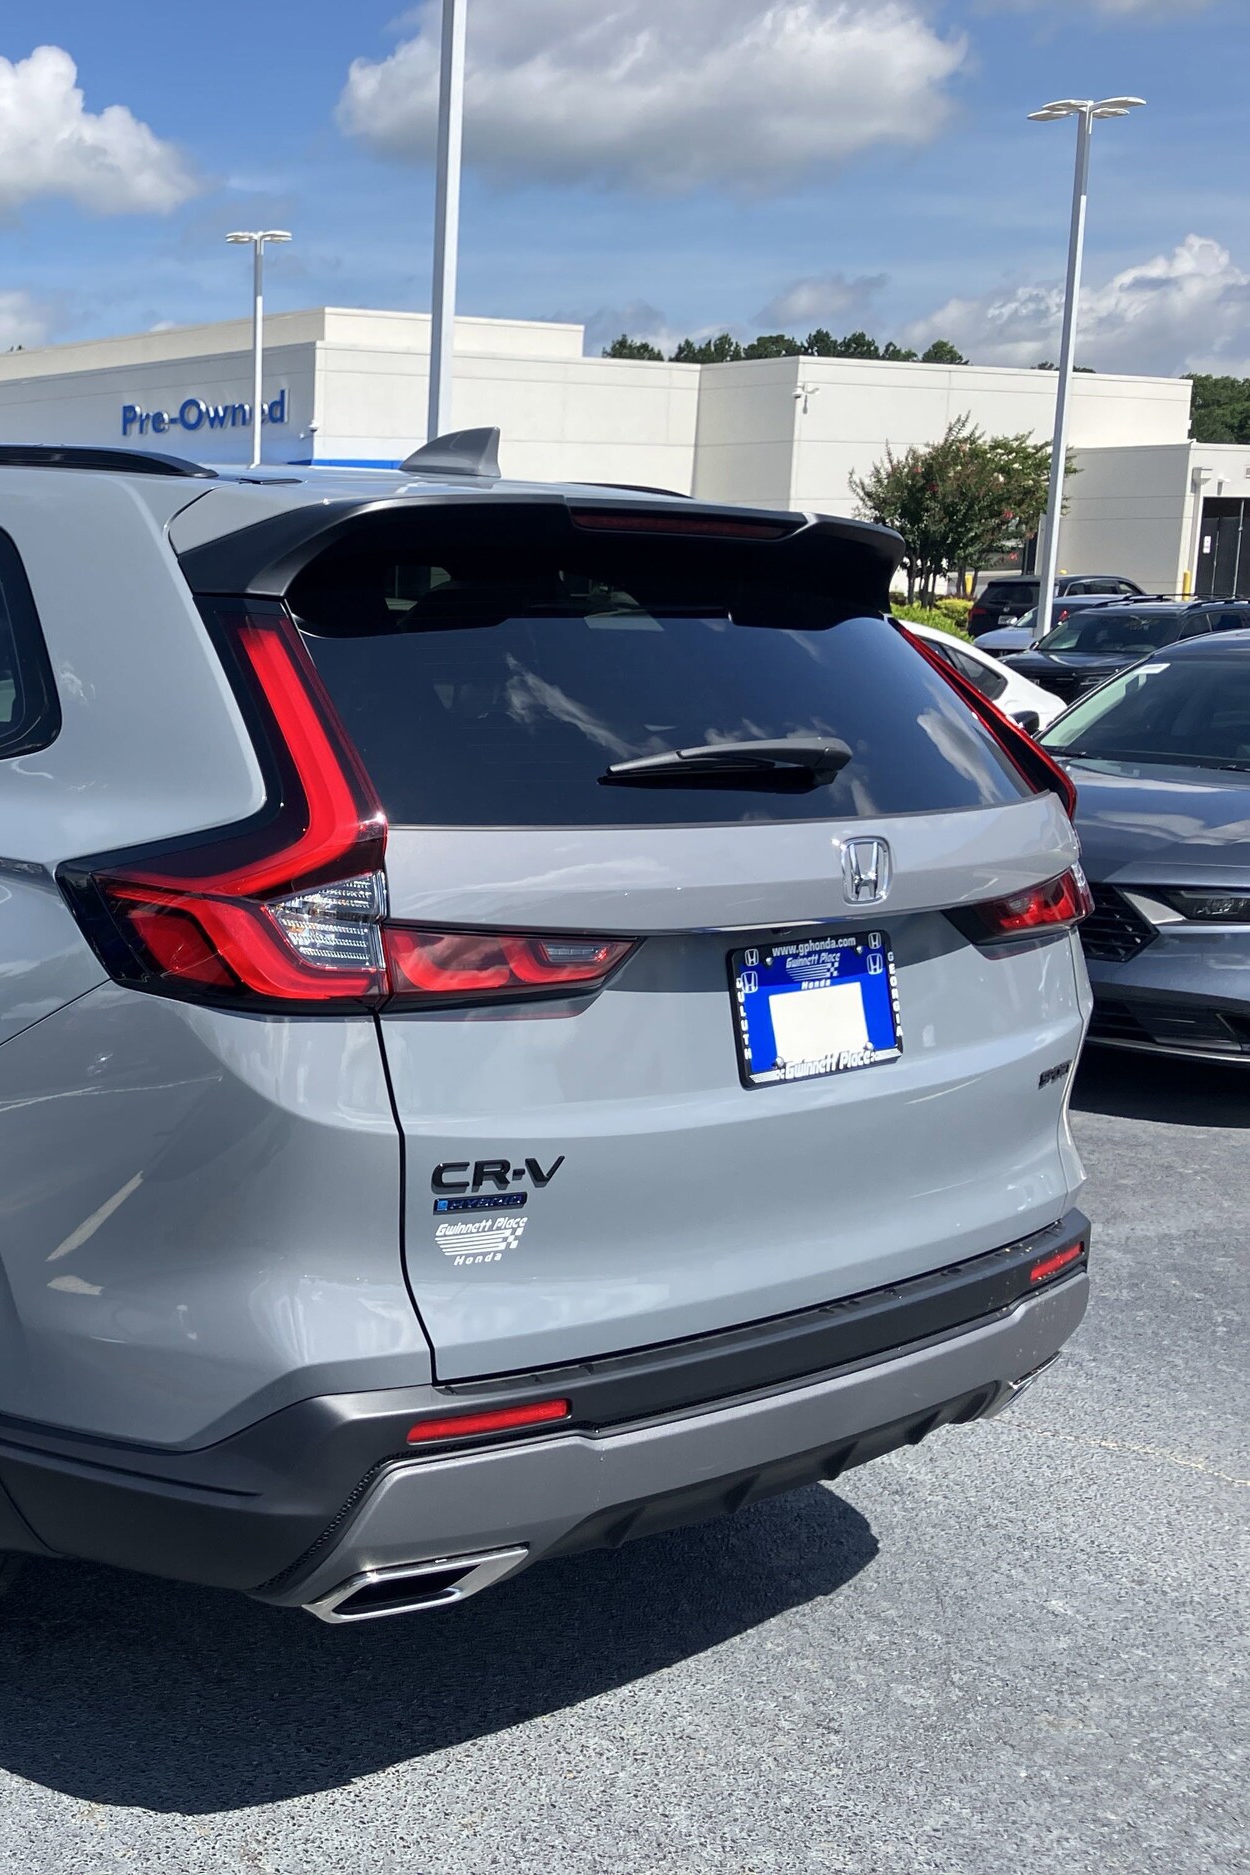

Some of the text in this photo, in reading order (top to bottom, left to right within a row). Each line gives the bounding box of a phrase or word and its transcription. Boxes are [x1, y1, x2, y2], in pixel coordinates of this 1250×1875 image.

[772, 937, 856, 957] www.gphonda.com
[785, 952, 841, 968] Gwinnett Place
[801, 979, 831, 990] Honda
[785, 1050, 870, 1079] Gwinnett Place
[431, 1155, 565, 1190] CR-V
[435, 1217, 528, 1236] Gwinnett Place
[453, 1252, 502, 1266] Honda
